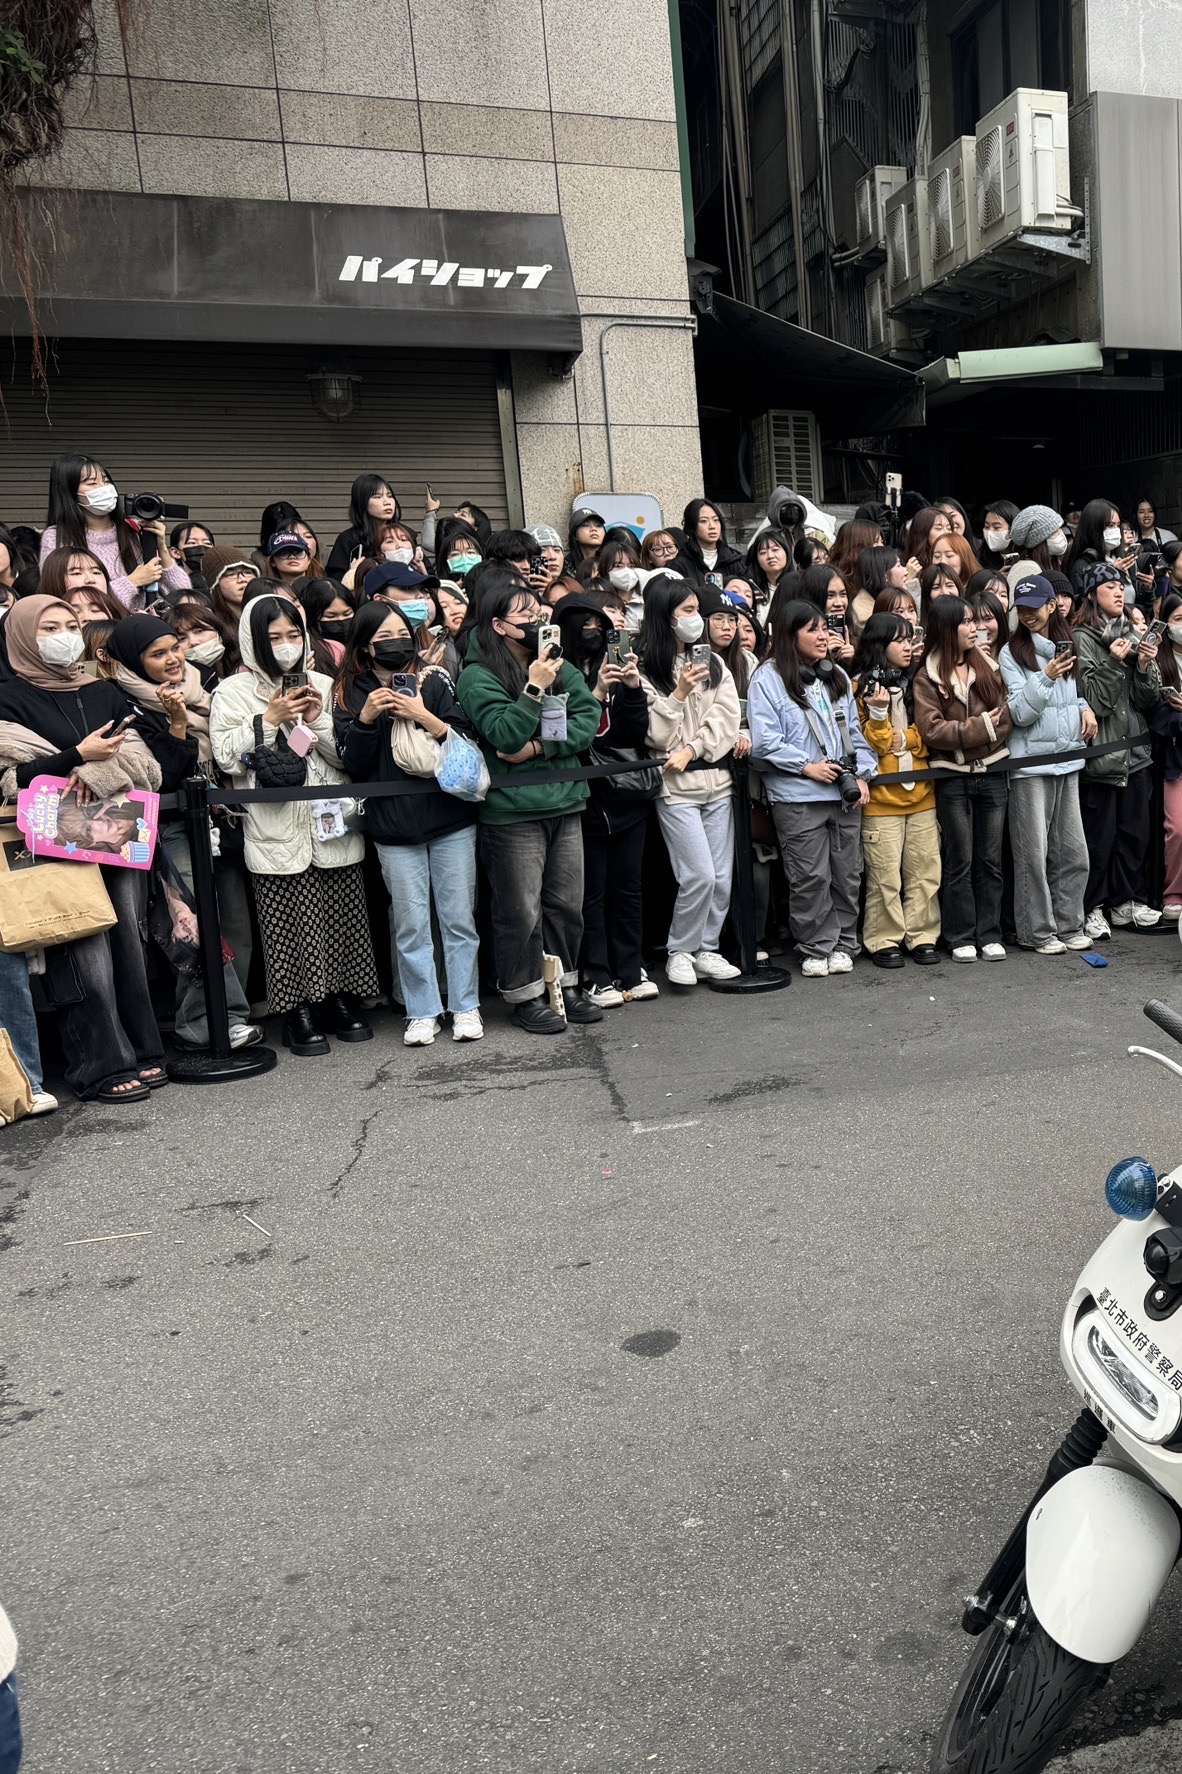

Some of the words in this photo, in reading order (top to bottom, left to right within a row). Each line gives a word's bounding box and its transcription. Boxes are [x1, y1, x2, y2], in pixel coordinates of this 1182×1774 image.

[338, 255, 553, 289] パイショップ
[720, 593, 733, 607] NY
[33, 794, 48, 833] Lucky
[44, 794, 59, 839] Charm
